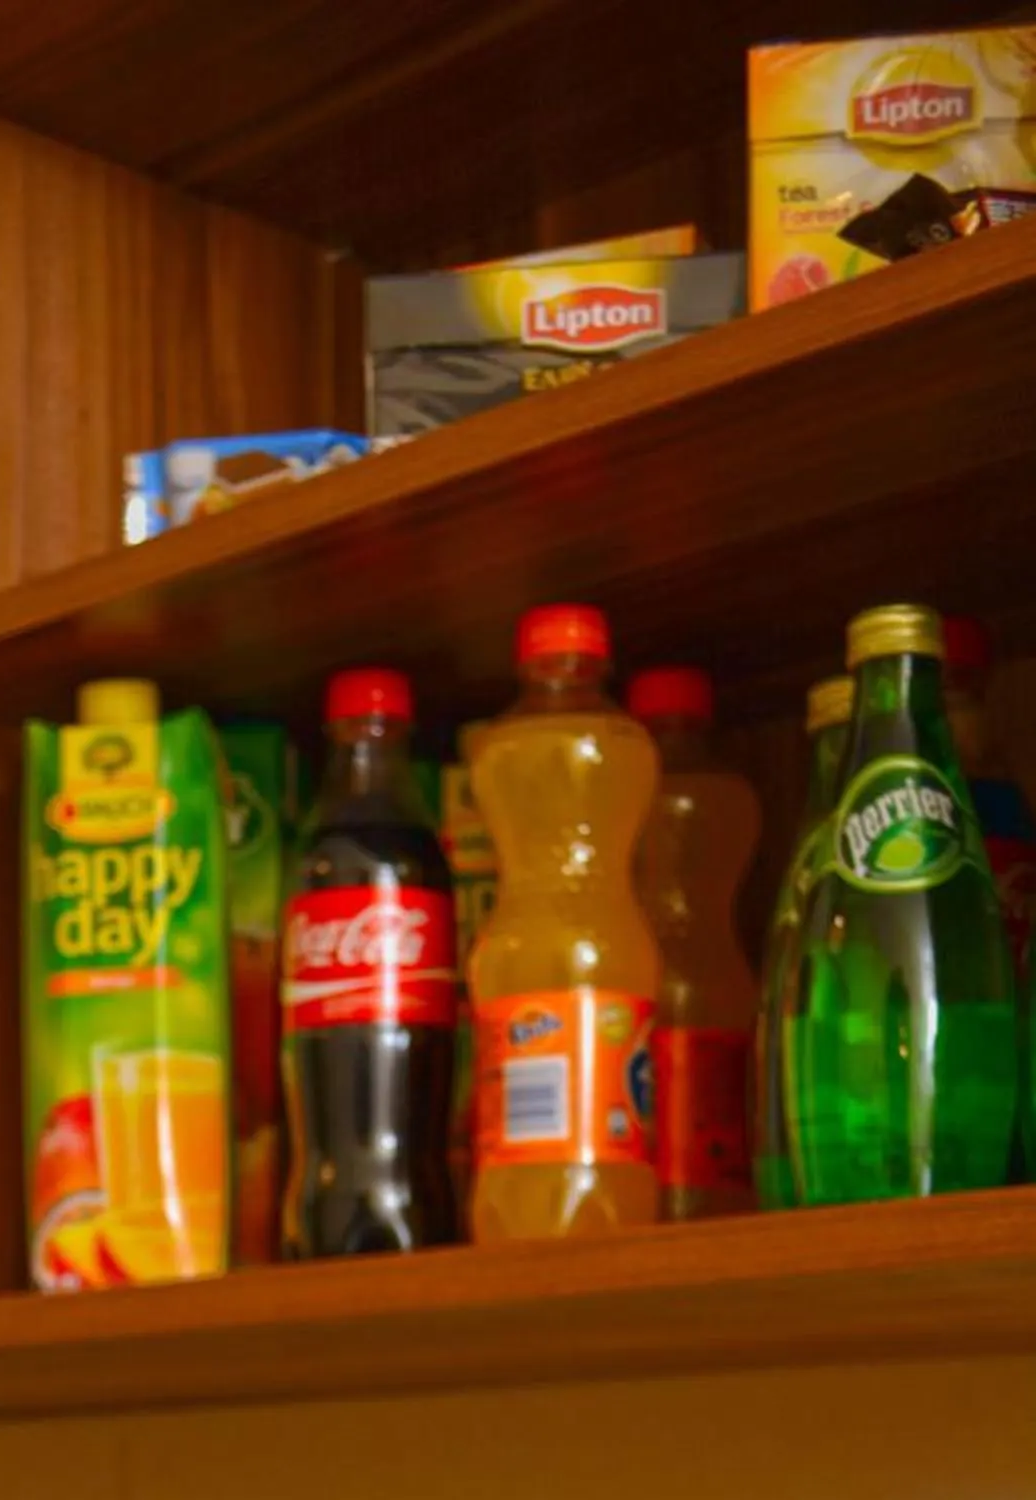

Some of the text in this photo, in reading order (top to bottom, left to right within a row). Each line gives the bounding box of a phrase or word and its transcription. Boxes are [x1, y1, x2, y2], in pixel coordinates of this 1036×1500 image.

[862, 94, 964, 128] Lipton
[534, 302, 653, 338] Lipton
[844, 776, 956, 879] perrier
[55, 900, 170, 967] day
